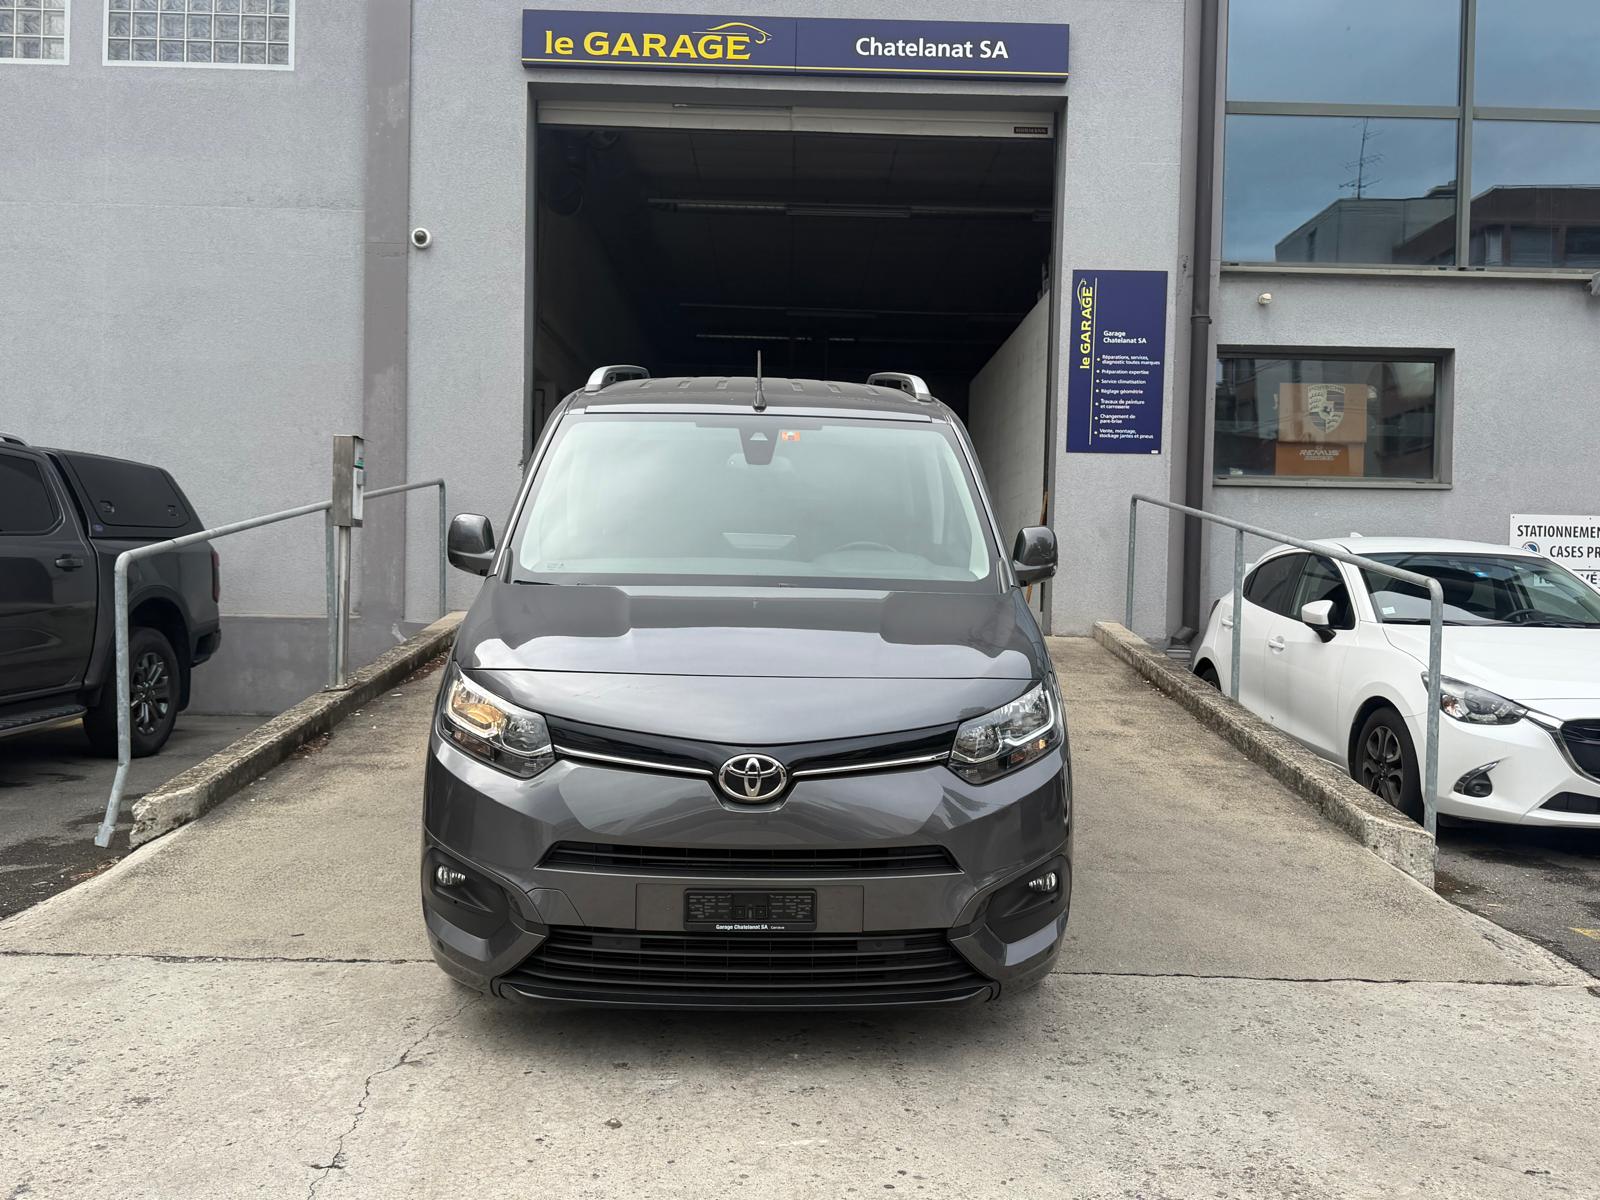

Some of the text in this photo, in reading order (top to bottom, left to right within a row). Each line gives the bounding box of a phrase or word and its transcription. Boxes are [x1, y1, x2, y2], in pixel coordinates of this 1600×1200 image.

[545, 30, 751, 60] le GARAGE
[856, 36, 1008, 58] Chatelanat SA
[1080, 286, 1092, 369] le GARAGE
[1550, 546, 1583, 558] CASES
